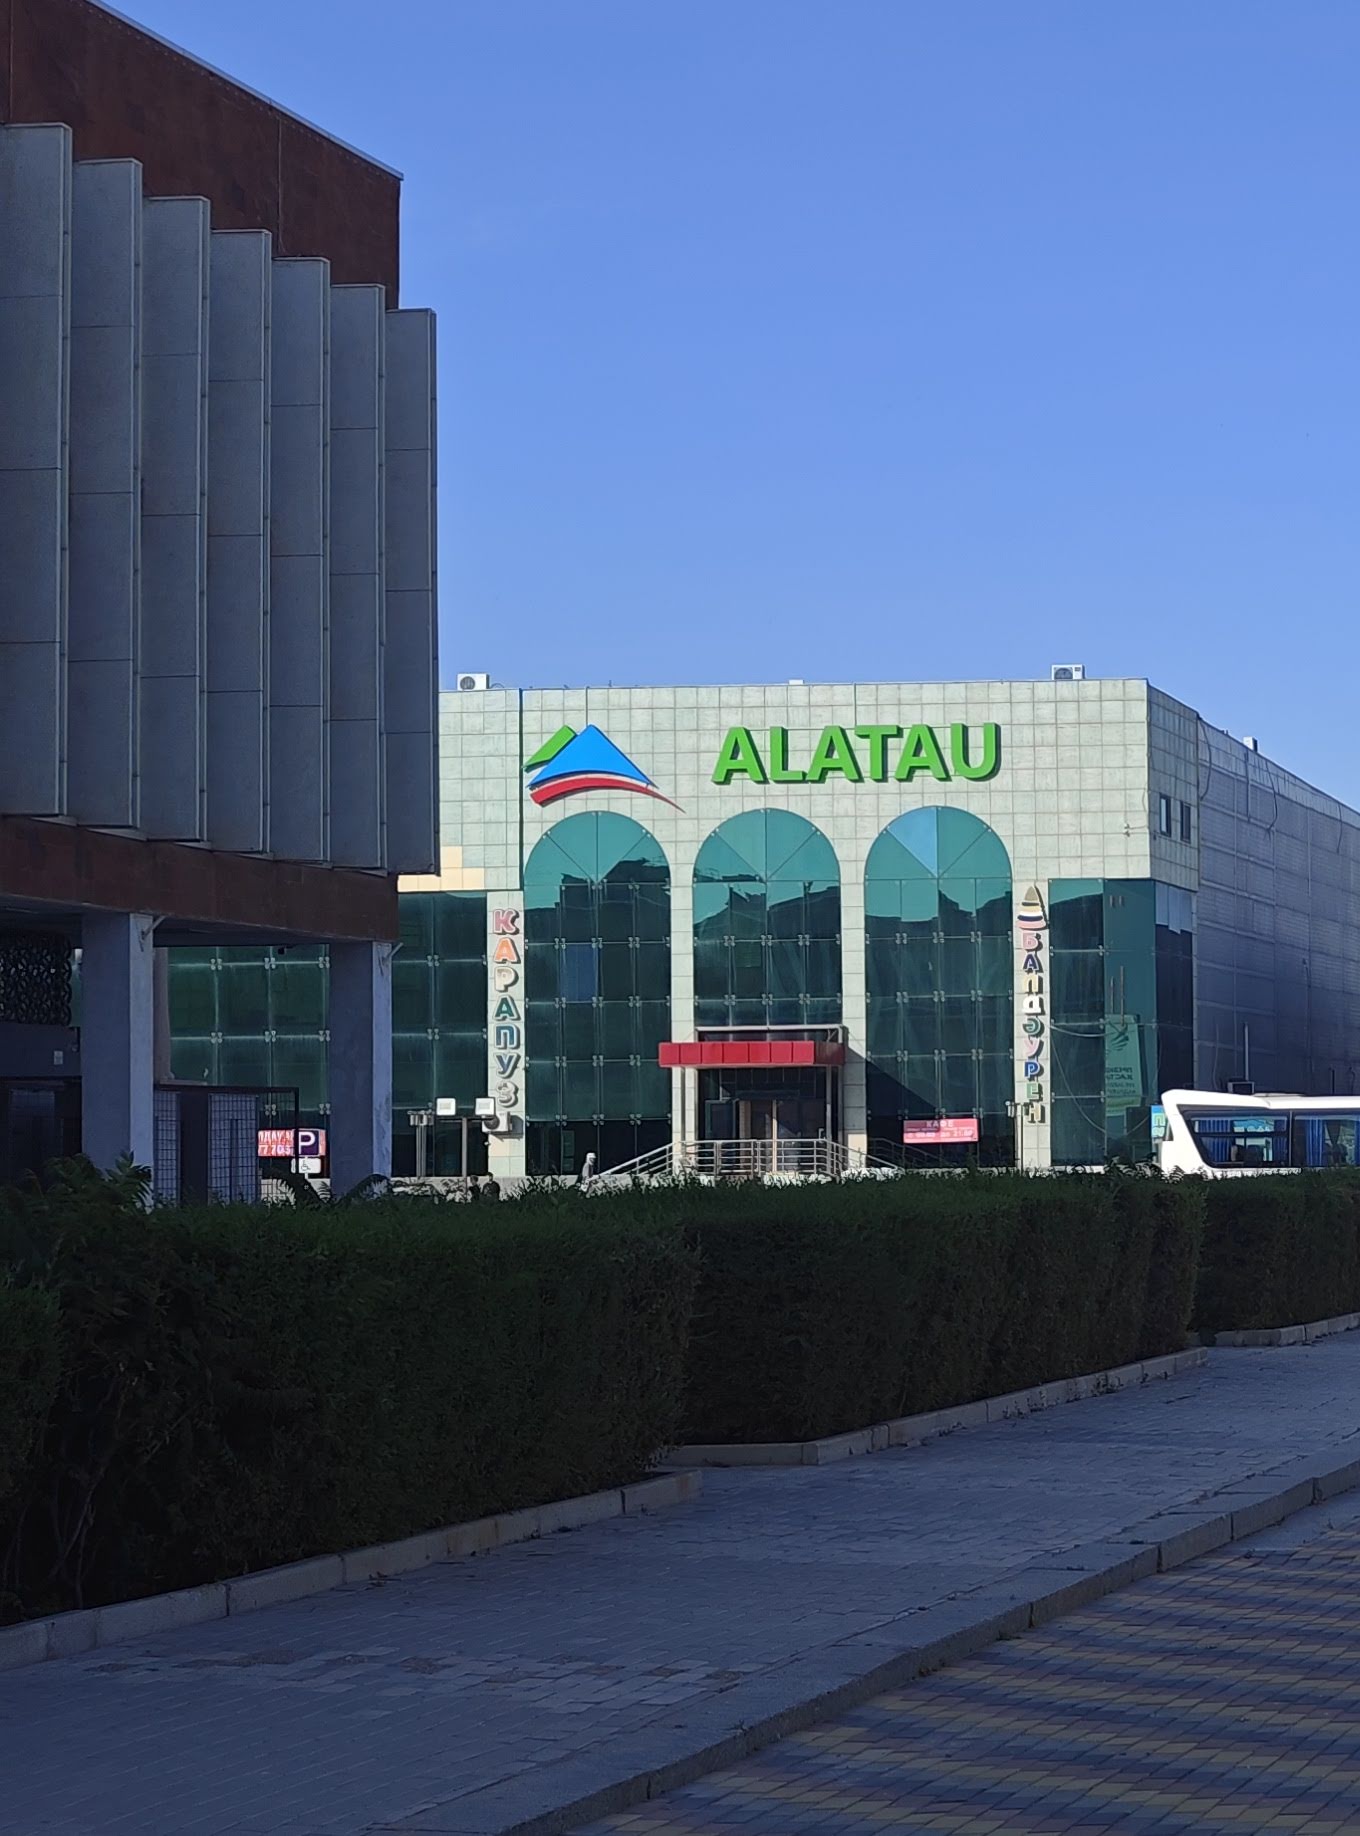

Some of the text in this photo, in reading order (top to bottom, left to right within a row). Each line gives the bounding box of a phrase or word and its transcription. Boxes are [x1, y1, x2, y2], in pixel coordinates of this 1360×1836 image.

[711, 722, 1001, 785] ALATAU
[492, 908, 521, 1109] КАРАПУЗ
[298, 1131, 316, 1155] P
